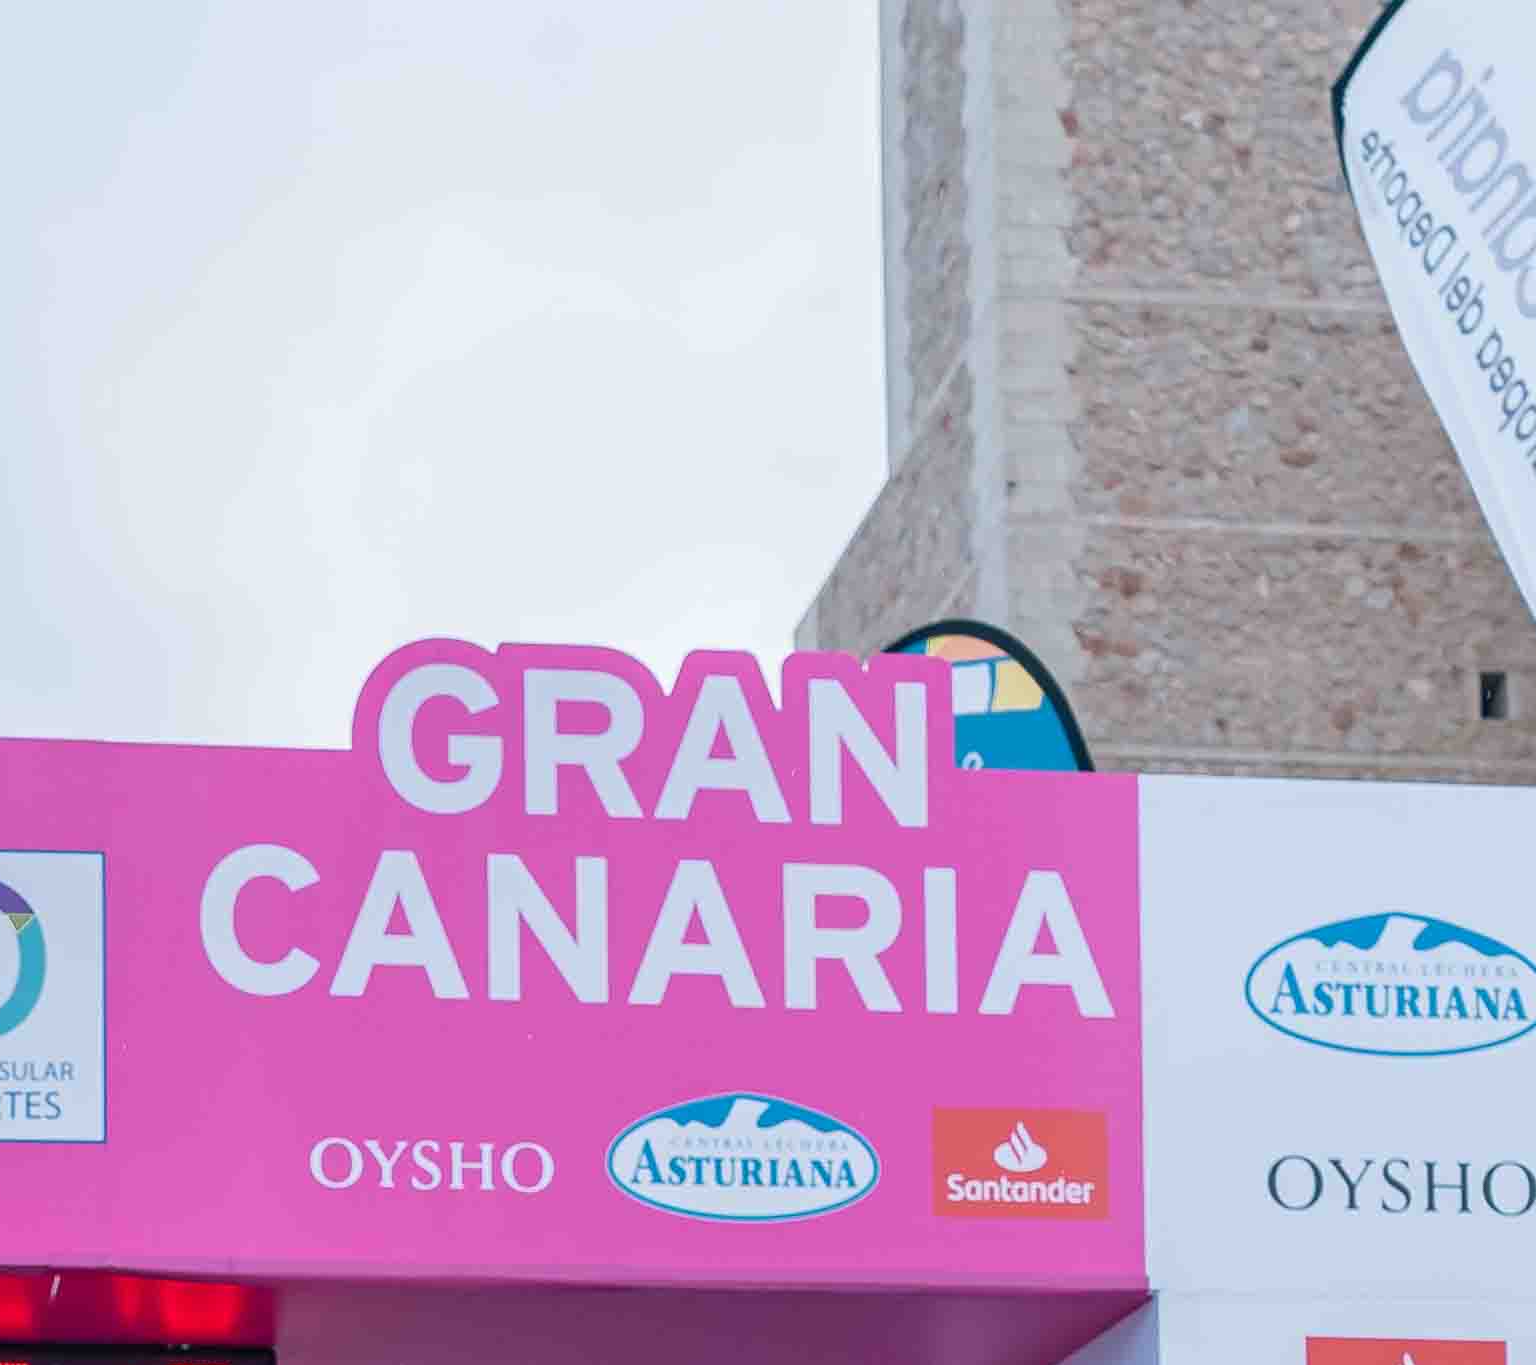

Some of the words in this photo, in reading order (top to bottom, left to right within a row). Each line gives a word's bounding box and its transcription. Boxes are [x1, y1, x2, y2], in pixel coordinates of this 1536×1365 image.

[377, 662, 929, 829] GRAN
[198, 843, 1116, 1020] CANARIA
[1269, 961, 1529, 1021] ASTURIANA
[308, 1134, 555, 1194] OYSHO
[631, 1138, 857, 1188] ASTURIANA
[946, 1173, 1095, 1206] Santander
